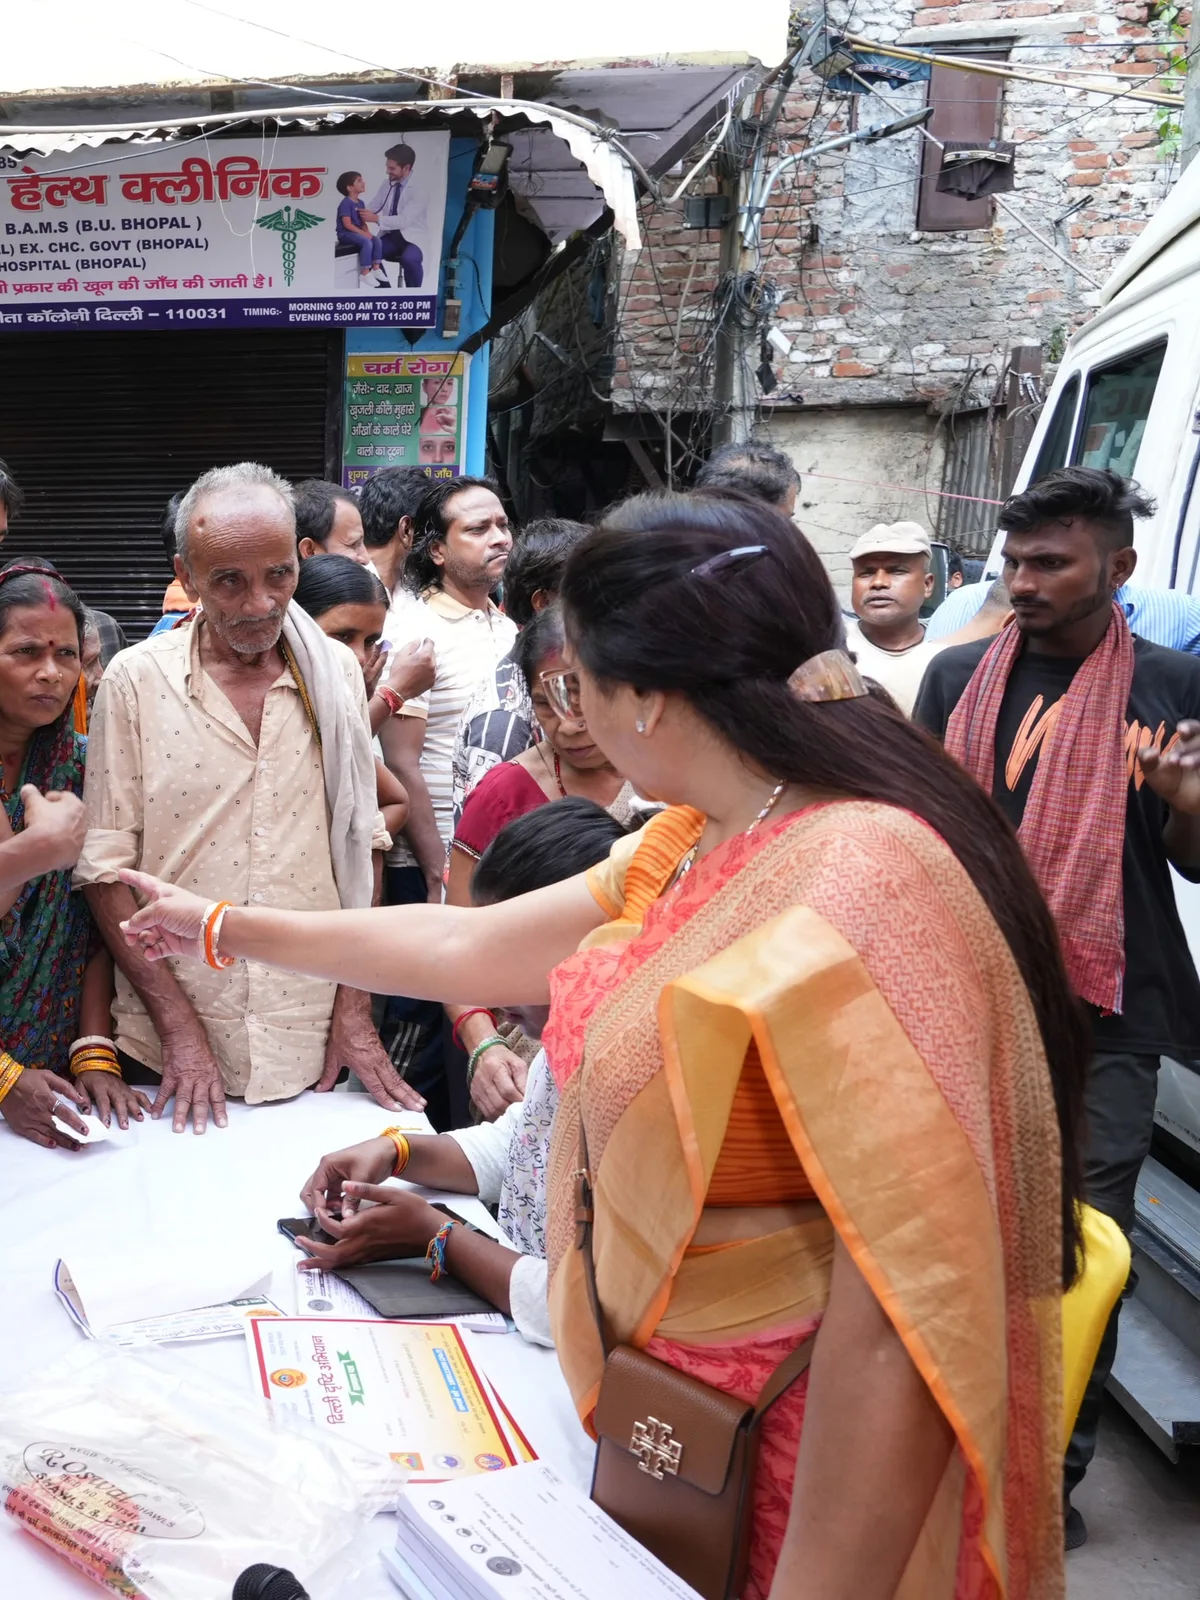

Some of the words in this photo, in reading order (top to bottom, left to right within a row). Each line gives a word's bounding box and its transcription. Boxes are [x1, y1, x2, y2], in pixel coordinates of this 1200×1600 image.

[8, 166, 109, 212] हेल्थ
[119, 156, 328, 205] क्लीनिक
[5, 221, 69, 235] B.A.M.S
[76, 219, 116, 235] (B.U.
[121, 216, 191, 231] BHOPAL
[19, 242, 44, 254] EX.
[48, 241, 85, 254] CHC.
[89, 239, 131, 252] GOVT
[136, 238, 209, 253] (BHOPAL)
[75, 257, 146, 272] (BHOPAL)
[12, 282, 53, 295] प्रकार
[57, 278, 80, 292] की
[83, 280, 113, 296] खून
[118, 276, 140, 291] की
[143, 275, 178, 290] जाँच
[182, 274, 204, 289] की
[208, 273, 247, 289] जाती
[243, 307, 282, 316] TIMING:-
[288, 302, 334, 311] MORNING
[336, 301, 357, 311] 9:00
[358, 301, 373, 310] AM
[375, 301, 388, 310] TO
[416, 300, 431, 310] PM
[27, 308, 91, 323] कॉलोनी
[94, 306, 144, 322] दिल्ली
[165, 308, 226, 320] 110031
[289, 313, 331, 322] EVENING
[333, 312, 354, 322] 5:00
[356, 312, 370, 321] PM
[373, 311, 386, 321] TO
[387, 311, 413, 321] 11:00
[416, 311, 430, 321] PM
[364, 357, 403, 375] चर्म
[407, 357, 451, 375] रोग
[394, 383, 413, 394] खाज
[349, 401, 374, 419] खुजली
[375, 400, 393, 415] कील
[373, 422, 381, 436] के
[382, 422, 400, 436] काले
[375, 446, 386, 456] का
[348, 470, 369, 483] शुगर
[434, 467, 453, 479] जाँच
[312, 1335, 332, 1371] अभियान
[317, 1372, 342, 1394] दृष्टि
[322, 1395, 346, 1425] दिल्ली
[133, 1503, 176, 1529] SHAWLS
